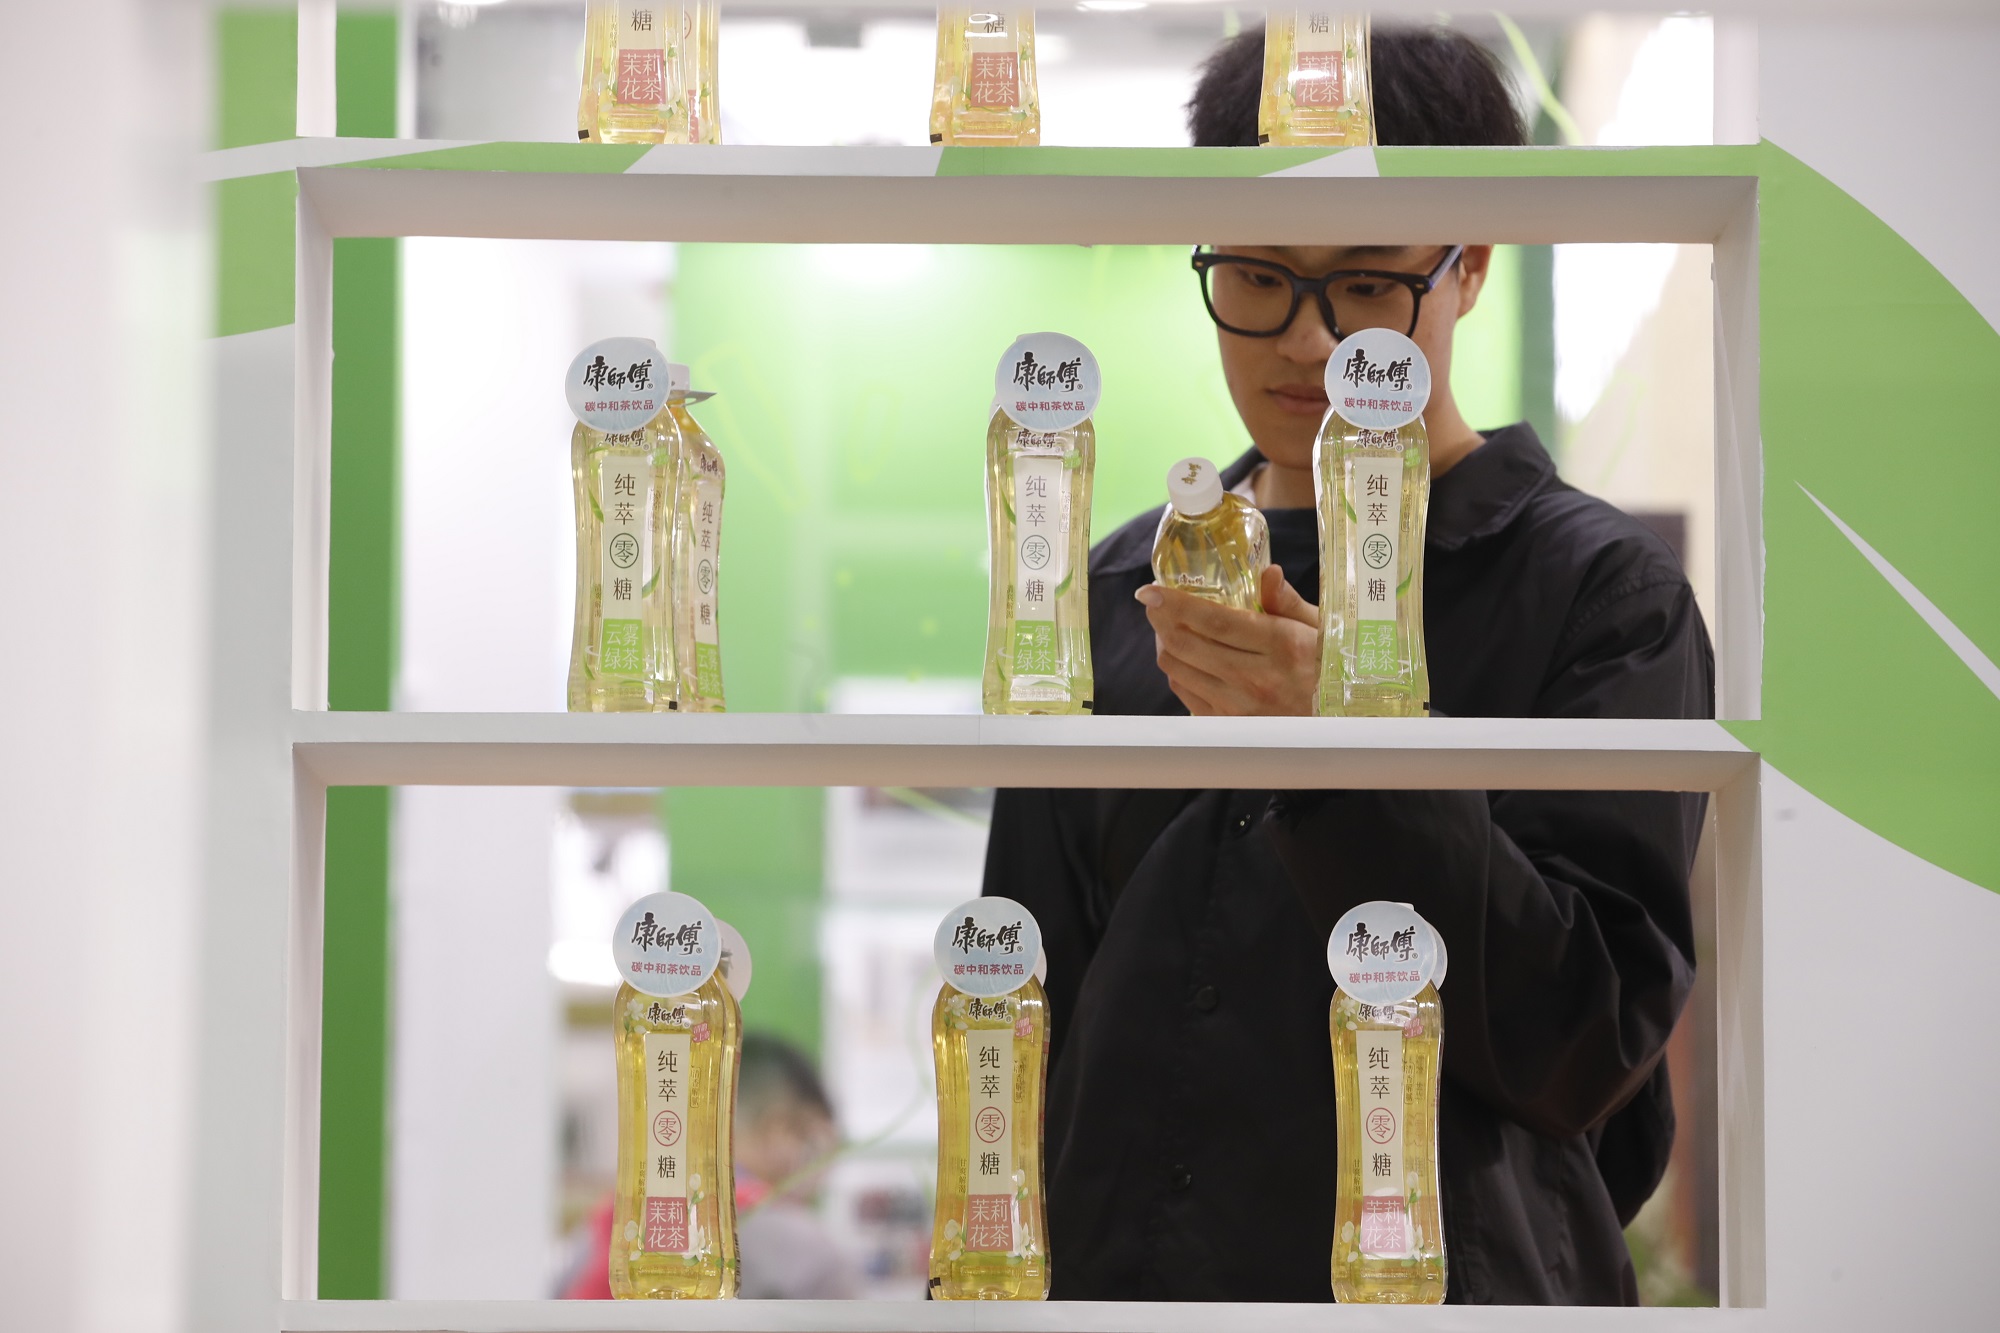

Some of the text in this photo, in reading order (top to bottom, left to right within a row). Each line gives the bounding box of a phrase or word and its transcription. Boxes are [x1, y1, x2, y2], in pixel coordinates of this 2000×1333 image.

[631, 9, 652, 31] 糖
[1309, 12, 1329, 34] 糖
[622, 53, 661, 76] 茉莉
[976, 56, 1014, 79] 茉莉
[621, 78, 661, 101] 花茶
[975, 81, 1014, 103] 花茶
[1300, 80, 1340, 103] 花茶
[585, 400, 654, 412] 碳中和茶饮品
[1016, 401, 1085, 411] 碳中和茶饮品
[1344, 397, 1413, 412] 碳中和茶饮品
[606, 624, 638, 646] 云雾
[1018, 625, 1050, 648] 云雾
[1362, 625, 1393, 648] 云雾
[604, 648, 639, 670] 绿茶
[1017, 650, 1051, 671] 绿茶
[1360, 650, 1394, 671] 绿茶
[631, 962, 702, 977] 碳中和茶饮品
[954, 964, 1024, 975] 碳中和茶饮品
[1349, 971, 1420, 983] 碳中和茶饮品
[650, 1201, 683, 1224] 茉莉
[971, 1199, 1008, 1222] 茉莉
[1367, 1201, 1400, 1224] 茉莉
[648, 1226, 685, 1248] 花茶
[970, 1224, 1009, 1248] 花茶
[1365, 1226, 1401, 1249] 花茶
